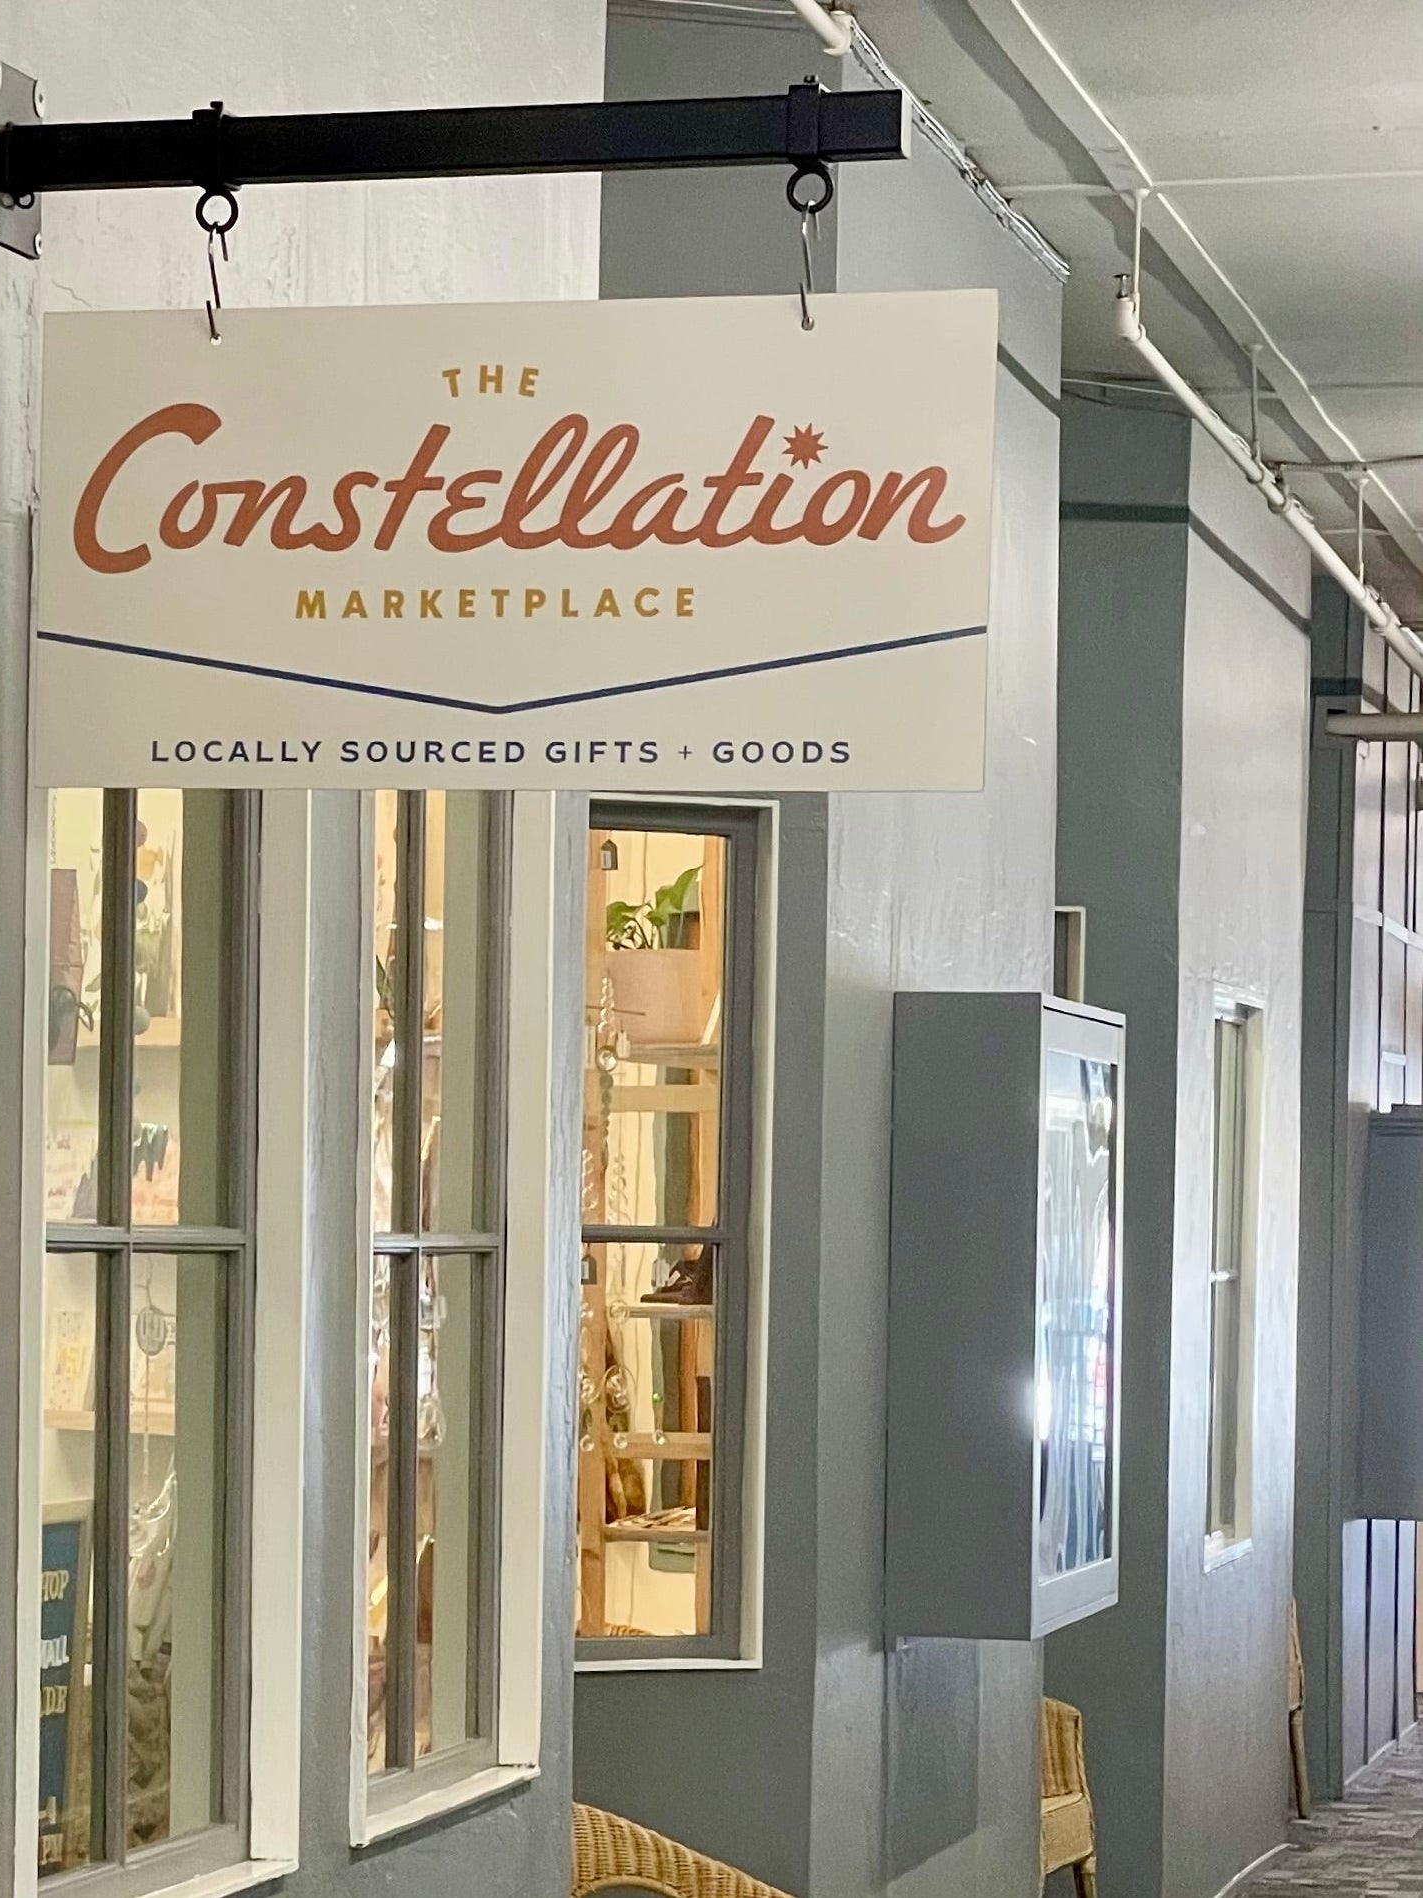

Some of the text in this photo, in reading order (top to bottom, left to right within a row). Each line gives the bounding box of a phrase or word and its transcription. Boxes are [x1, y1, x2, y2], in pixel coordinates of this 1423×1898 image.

[441, 364, 540, 398] THE
[72, 402, 967, 575] Constellation
[295, 587, 695, 620] MARKETPLACE
[151, 740, 322, 764] LOCALLY
[339, 740, 526, 764] SOURCED
[545, 740, 659, 764] GIFTS
[712, 740, 851, 764] GOODS
[41, 1570, 69, 1601] HOP
[41, 1635, 69, 1669] ALL
